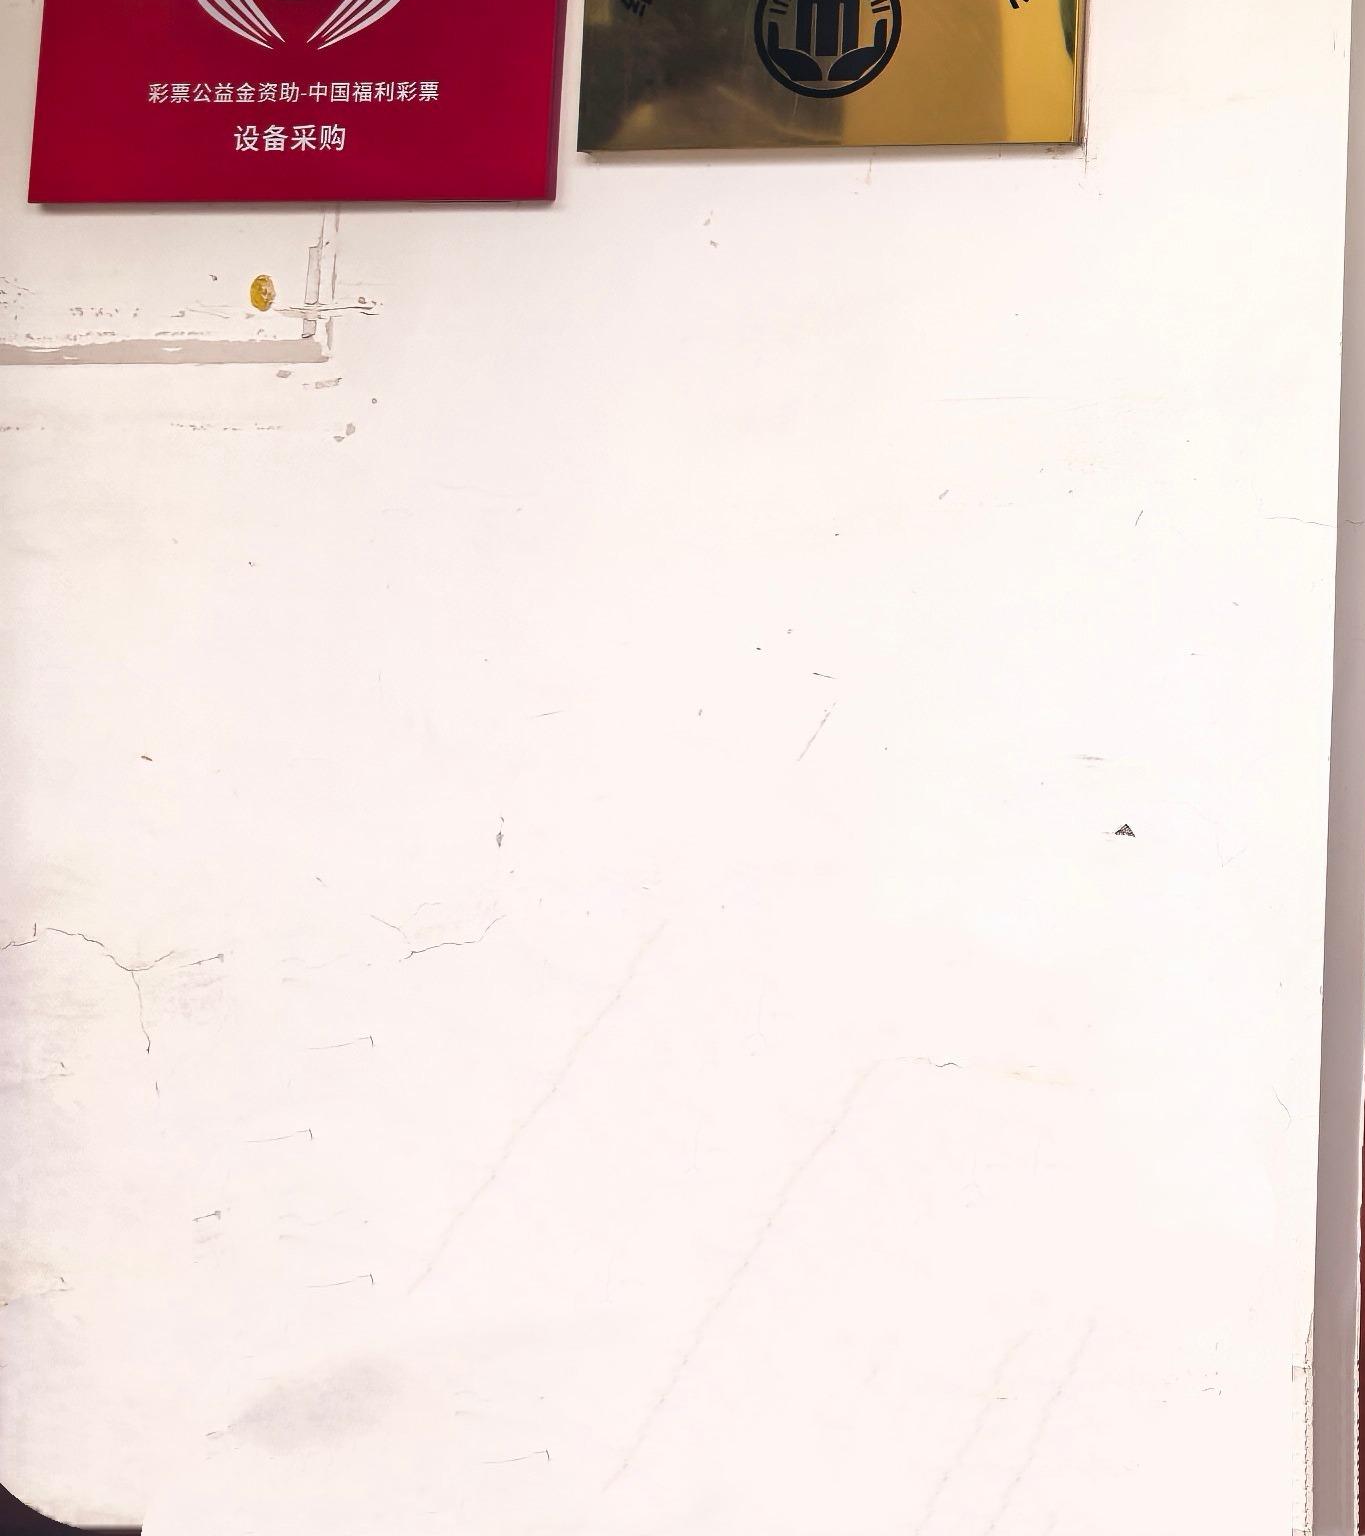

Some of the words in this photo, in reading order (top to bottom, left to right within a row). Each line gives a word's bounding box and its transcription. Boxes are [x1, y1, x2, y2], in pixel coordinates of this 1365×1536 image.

[148, 80, 440, 105] 彩票公益金资助-中国福利彩票
[233, 123, 347, 153] 设备采购
